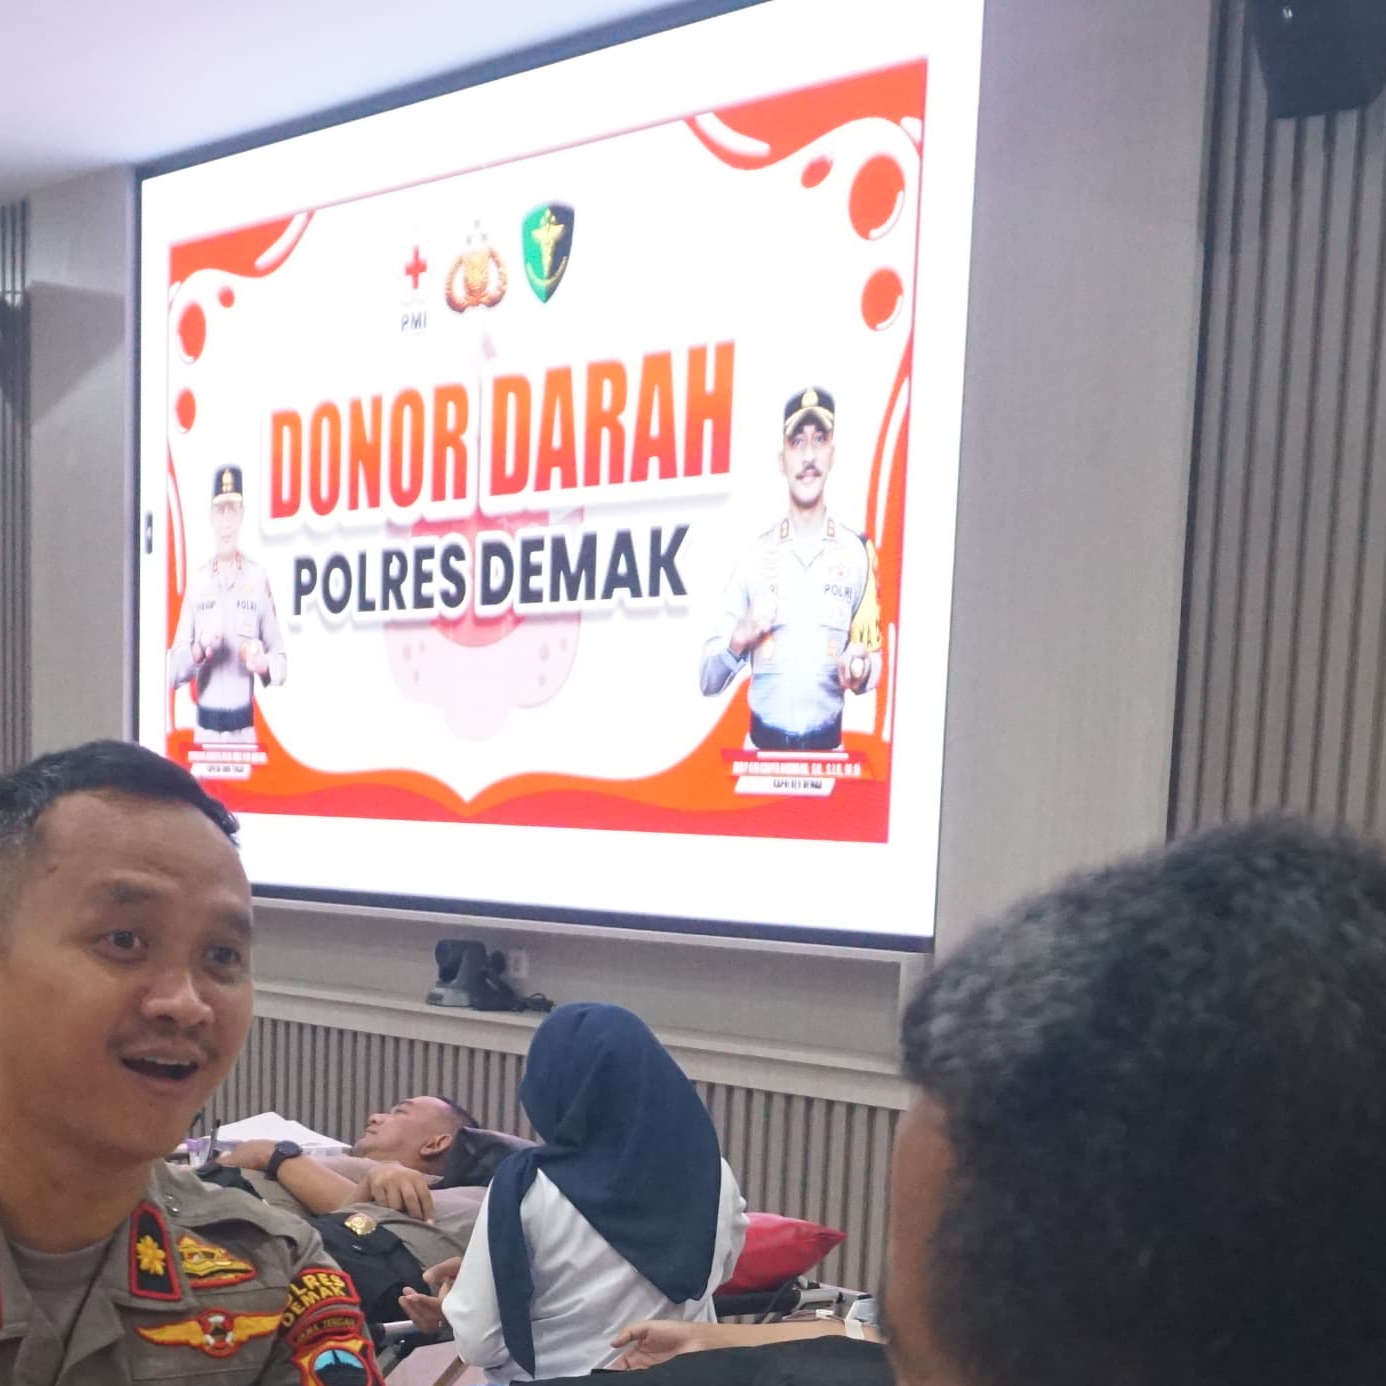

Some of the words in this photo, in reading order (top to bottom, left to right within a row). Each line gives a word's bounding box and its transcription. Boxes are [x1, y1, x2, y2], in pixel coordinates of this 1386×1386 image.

[401, 312, 427, 332] PMI
[270, 382, 469, 519] DONOR
[489, 340, 735, 497] DARAH
[293, 543, 467, 616] POLRES
[480, 523, 690, 606] DEMAK
[823, 583, 852, 601] POLRI
